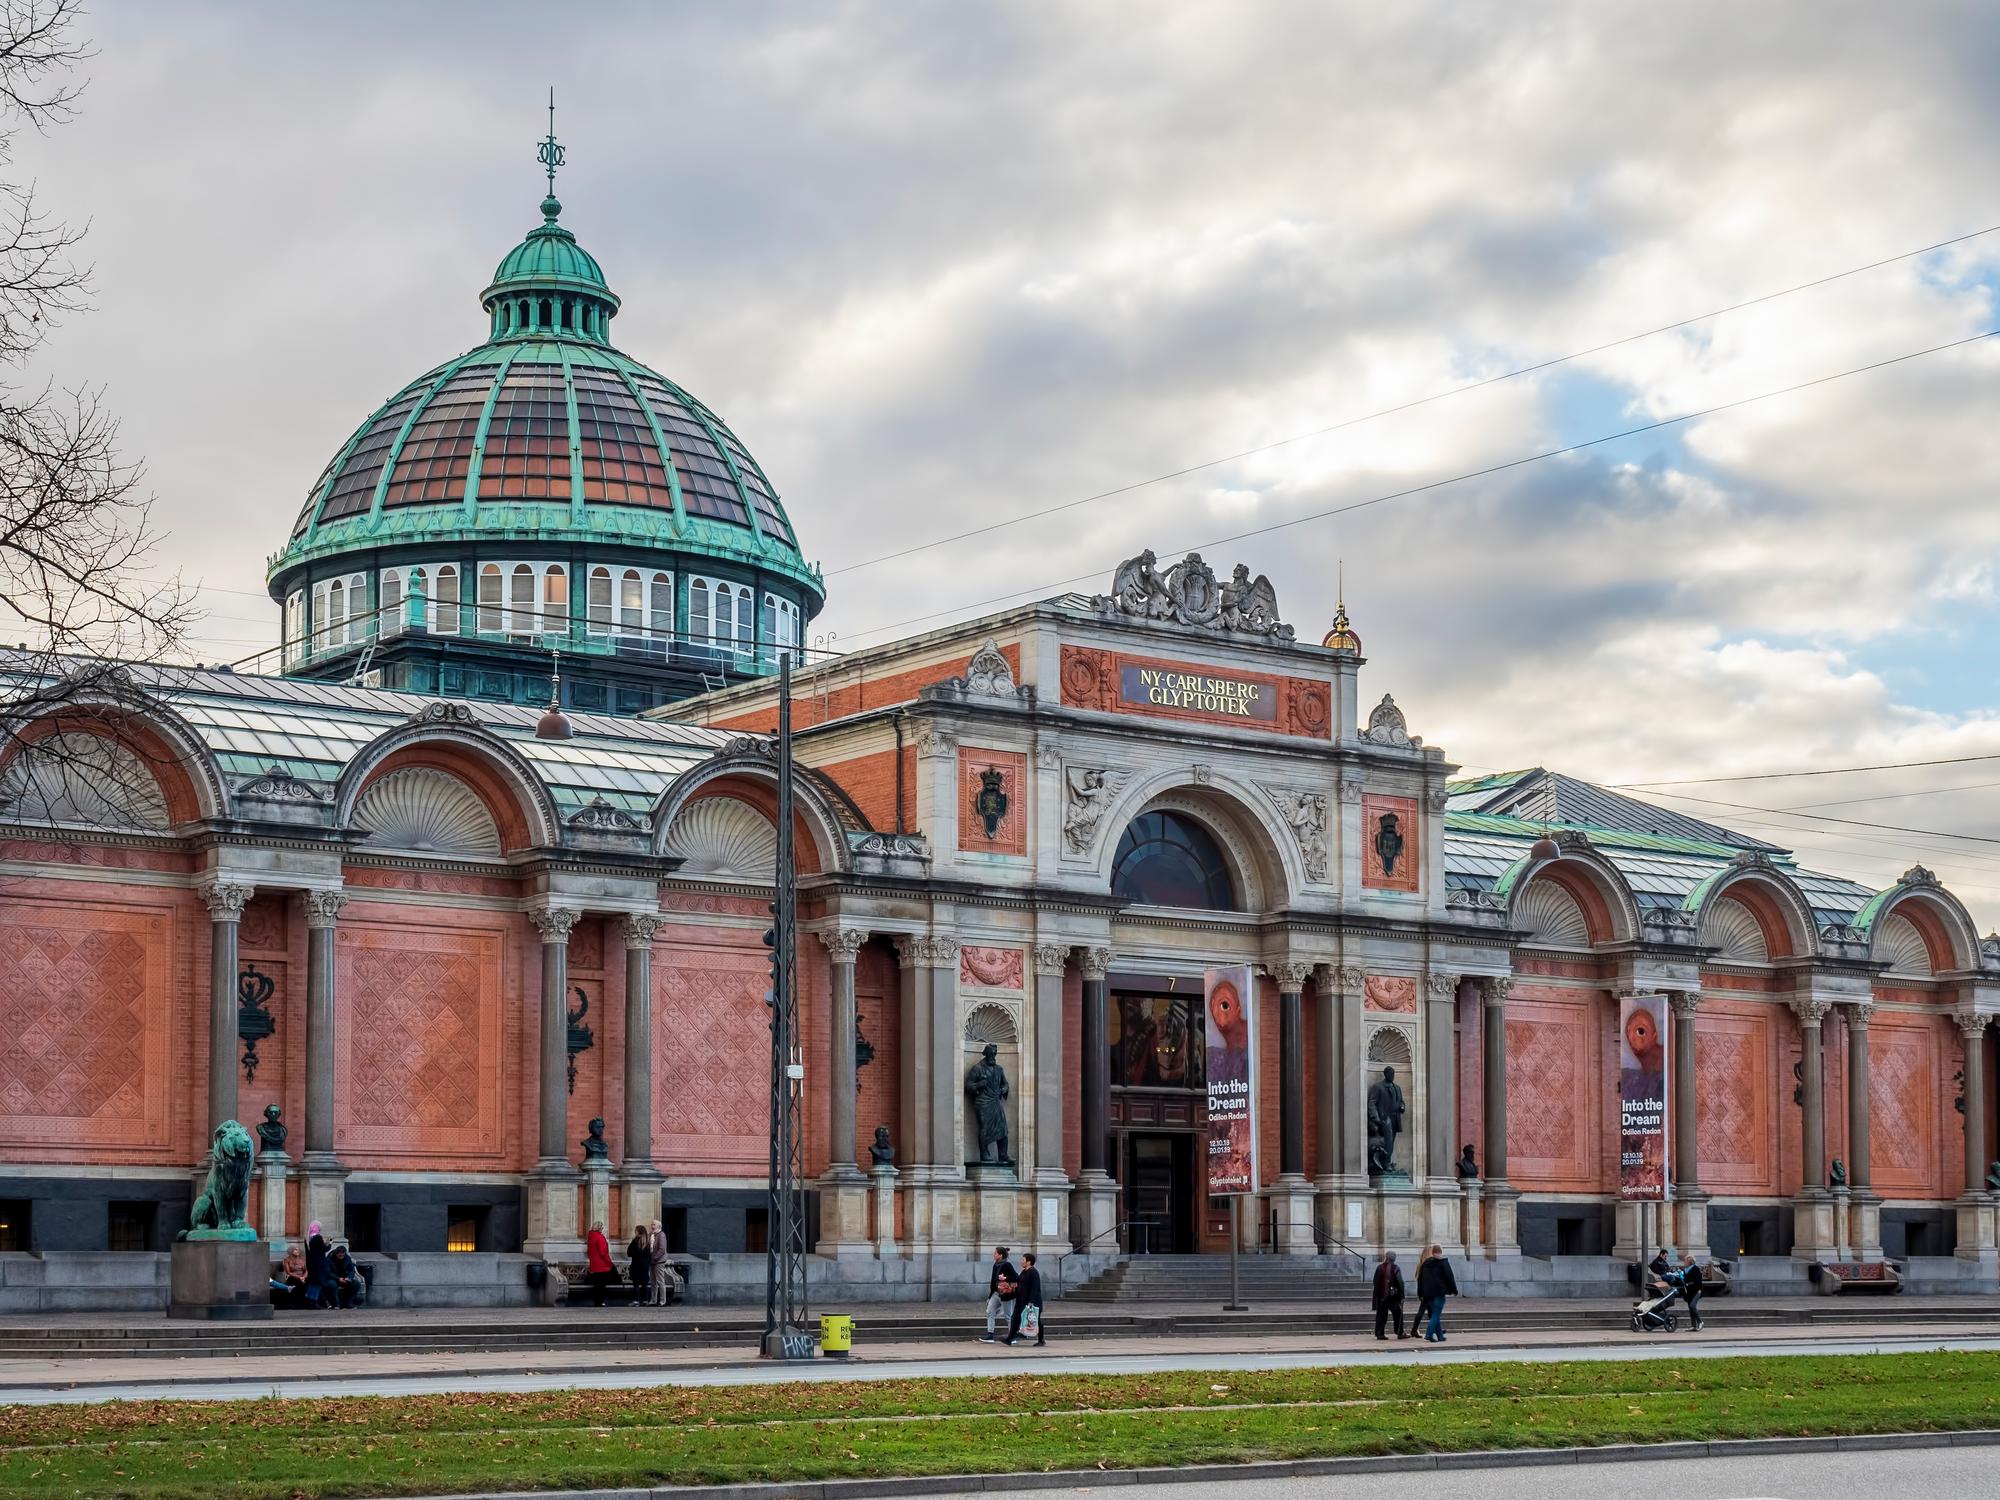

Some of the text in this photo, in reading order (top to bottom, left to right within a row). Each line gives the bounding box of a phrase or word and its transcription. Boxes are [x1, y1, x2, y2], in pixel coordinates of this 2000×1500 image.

[1140, 669, 1259, 700] NY-CARLSBERG
[1149, 687, 1251, 716] GLYPTOTEK
[1168, 976, 1176, 992] 7
[1208, 1078, 1249, 1096] Into the
[1208, 1096, 1246, 1111] Dream
[1622, 1097, 1663, 1112] Into the
[1208, 1113, 1228, 1122] Odilon
[1622, 1113, 1661, 1126] Dream
[1622, 1128, 1642, 1136] Odilon
